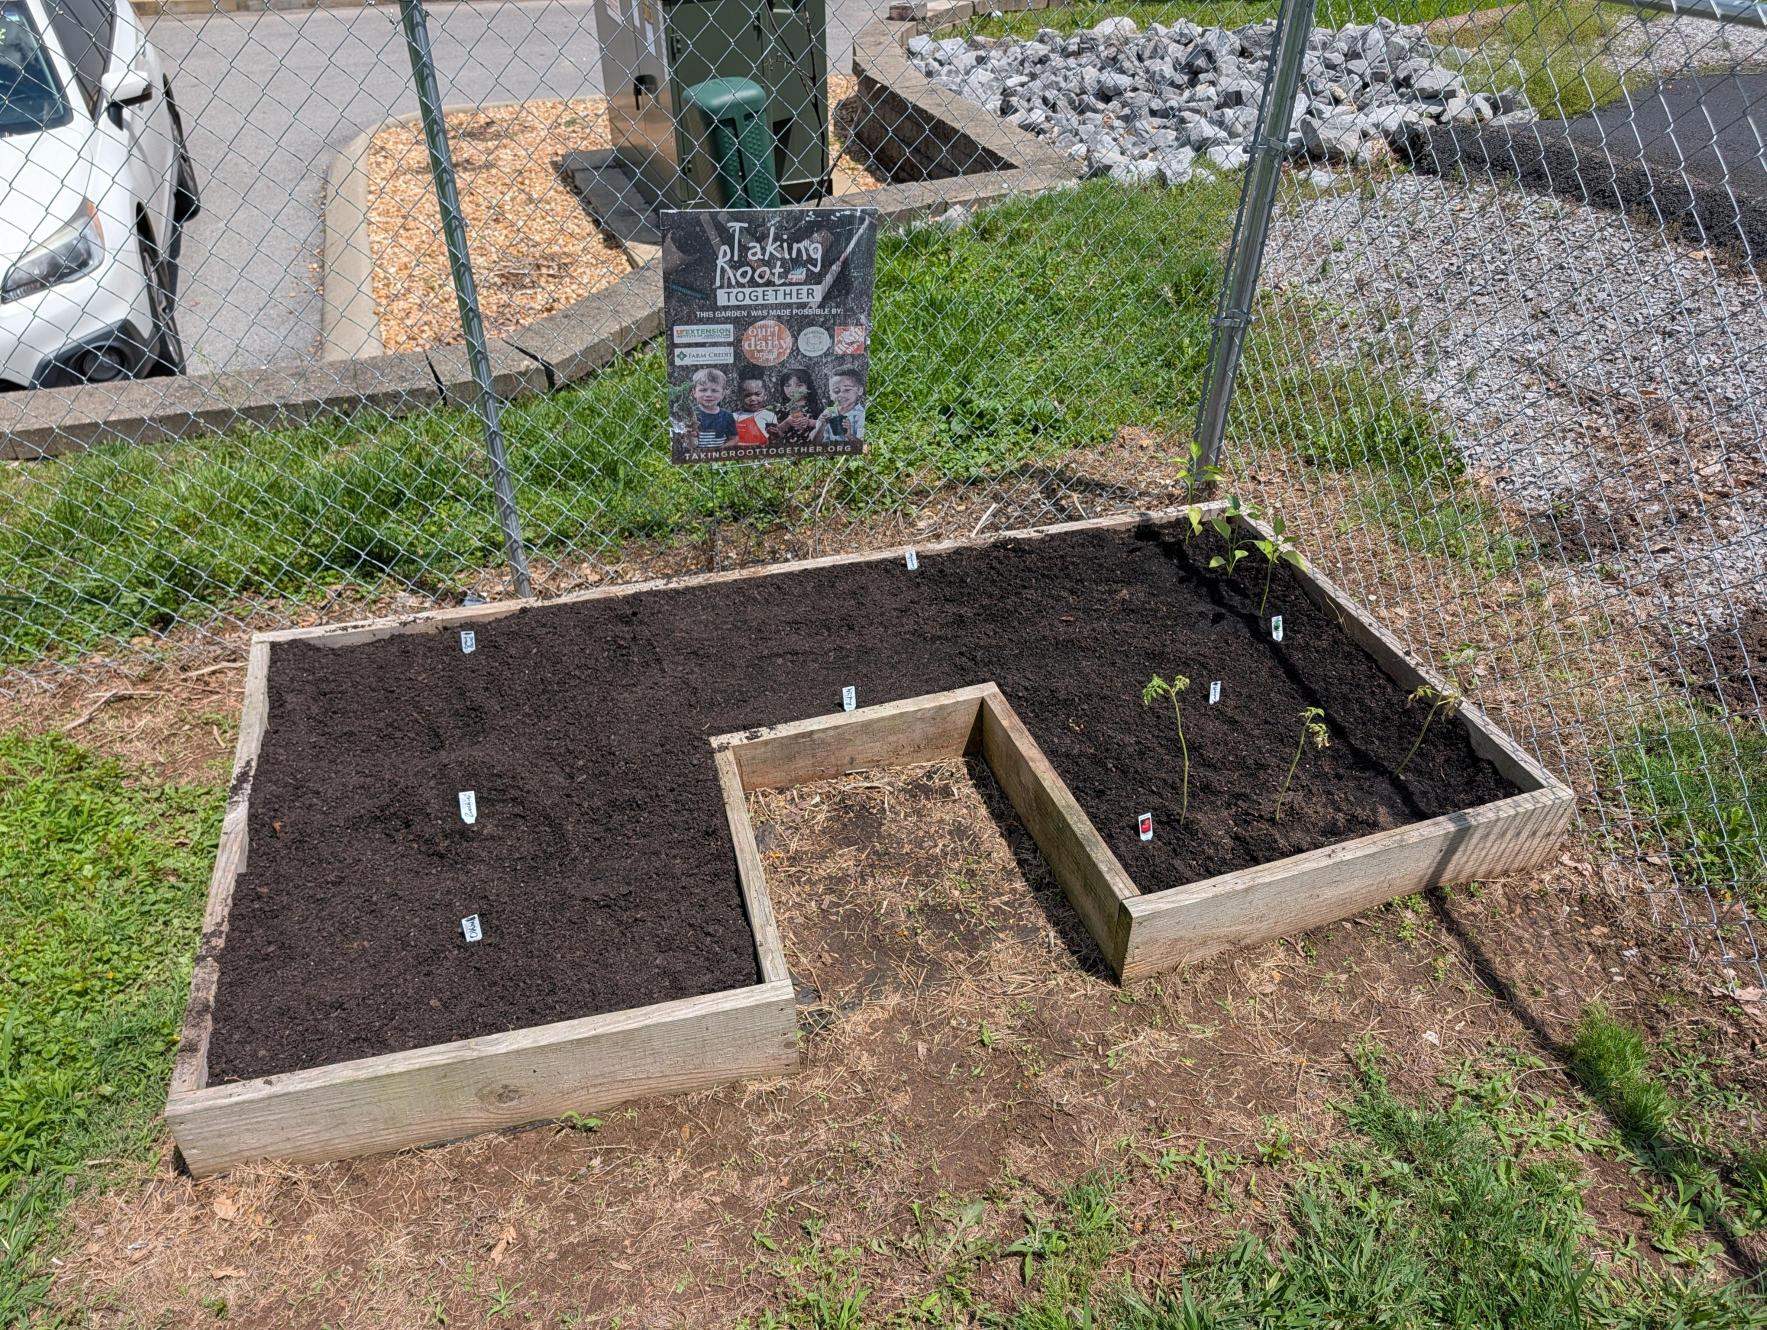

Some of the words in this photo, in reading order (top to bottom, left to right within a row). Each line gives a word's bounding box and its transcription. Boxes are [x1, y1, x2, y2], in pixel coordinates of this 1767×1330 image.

[727, 222, 822, 273] Taking
[715, 244, 786, 287] Root
[724, 287, 816, 303] TOGETHER
[715, 310, 748, 318] GARDEN
[750, 309, 768, 317] WAS
[792, 308, 830, 316] POSSIBLE
[708, 351, 732, 359] CREDIT
[685, 445, 852, 461] TAKINGROOTTOGETHER.ORG
